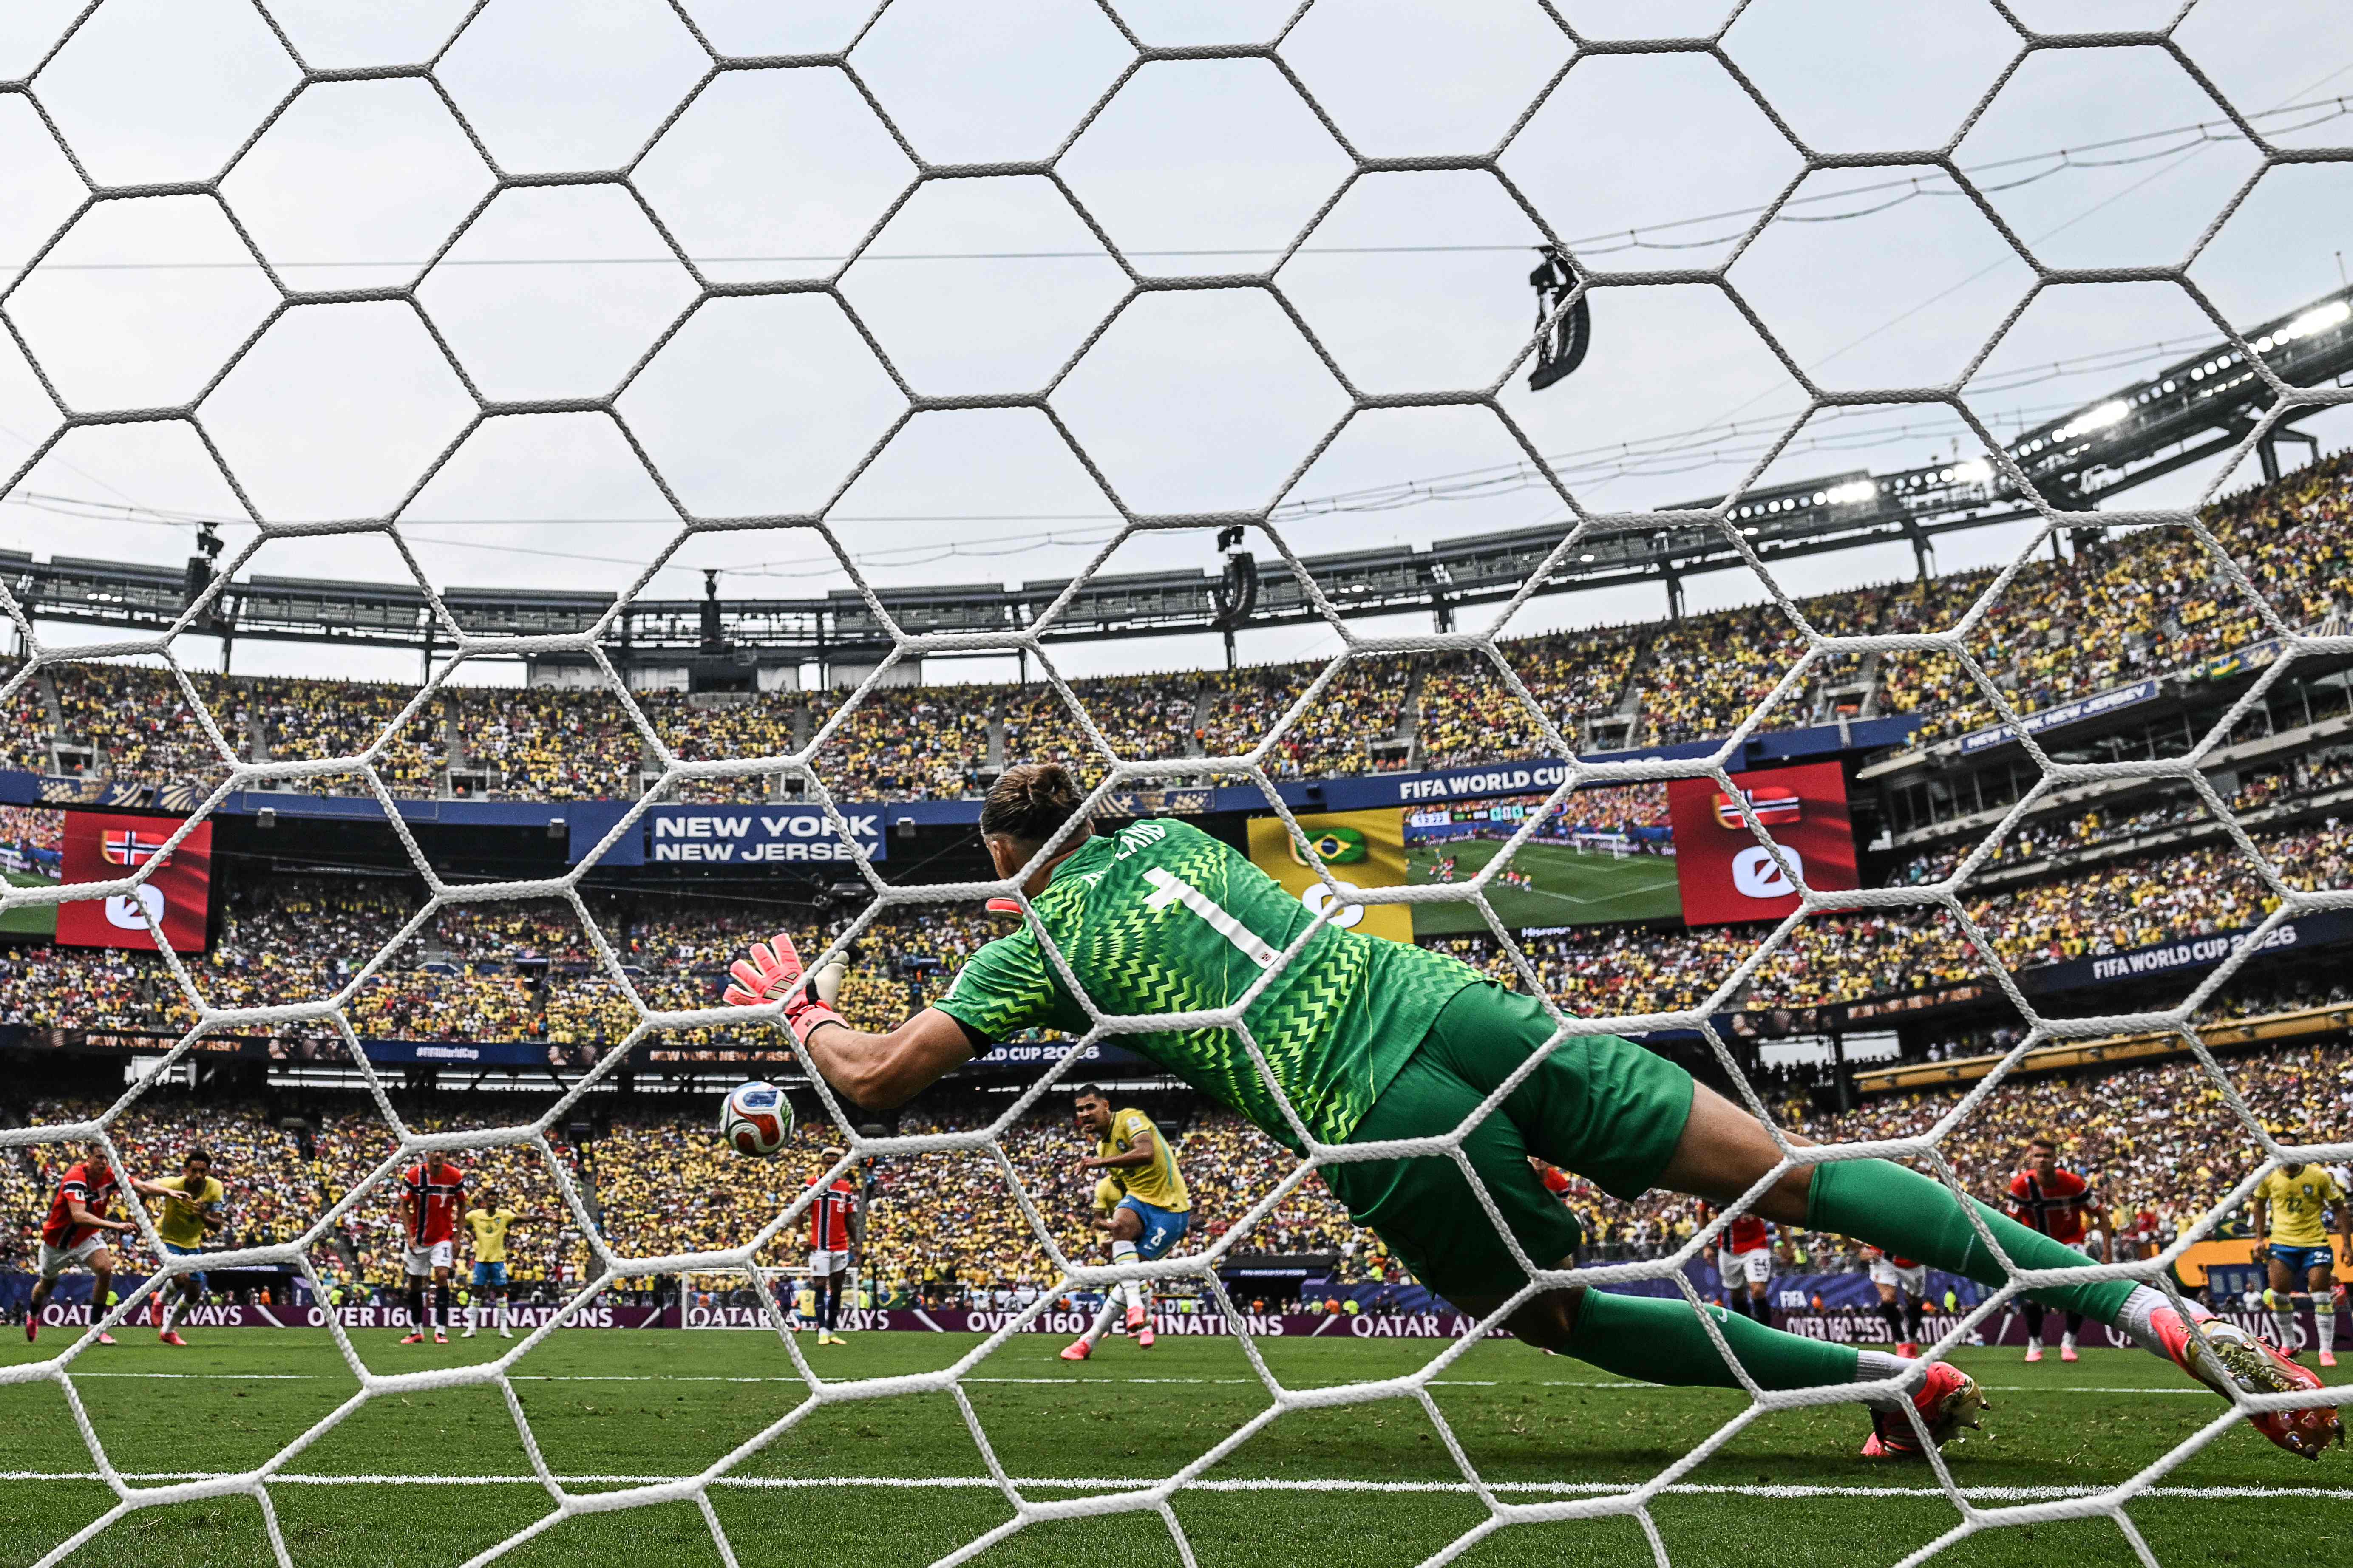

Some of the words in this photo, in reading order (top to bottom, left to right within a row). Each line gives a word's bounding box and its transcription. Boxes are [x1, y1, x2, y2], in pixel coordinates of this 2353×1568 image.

[1400, 778, 1448, 800] FIFA
[1449, 770, 1531, 795] WORLD
[655, 817, 751, 837] NEW
[760, 815, 879, 837] YORK
[655, 843, 734, 861] NEW
[741, 843, 879, 861] JERSEY
[1142, 866, 1283, 969] 1
[2092, 957, 2130, 979] FIFA
[2129, 944, 2191, 974] WORLD
[2192, 937, 2229, 961] CUP
[2230, 925, 2297, 952] 226
[1009, 1047, 1041, 1061] CUP
[1043, 1046, 1100, 1060] 206
[1780, 1290, 1807, 1308] FIFA
[680, 1307, 772, 1328] QATAR
[1044, 1313, 1085, 1333] 160
[1351, 1315, 1441, 1337] QATAR
